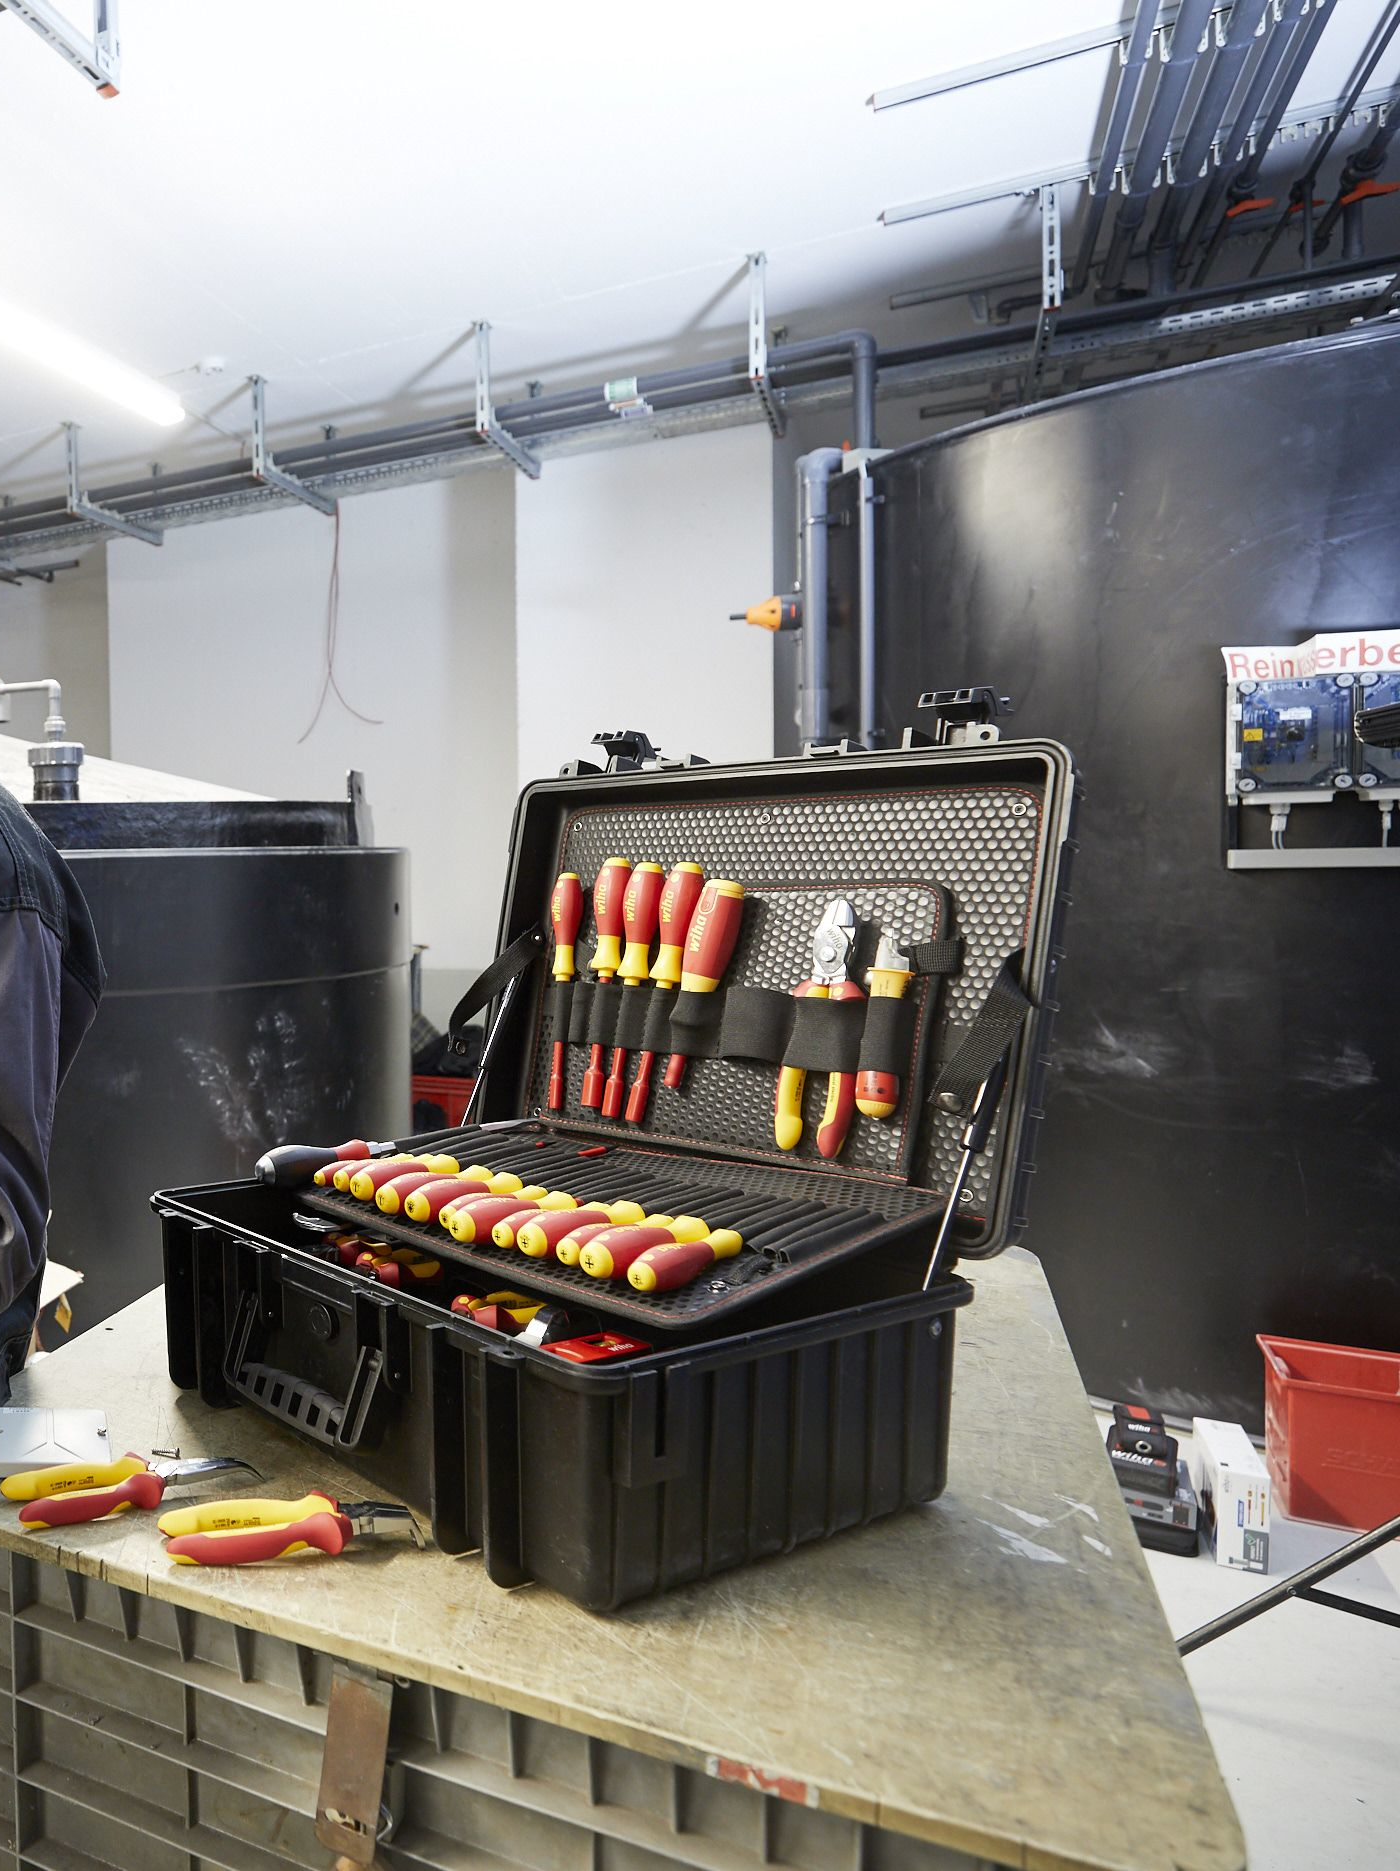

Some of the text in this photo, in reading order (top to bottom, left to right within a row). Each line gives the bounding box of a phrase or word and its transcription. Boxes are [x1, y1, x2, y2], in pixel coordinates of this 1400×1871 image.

[552, 895, 561, 922] wiha
[596, 884, 607, 915] wiha
[625, 890, 636, 922] wiha
[661, 890, 674, 923] wiha
[689, 914, 707, 952] wiha
[608, 1343, 634, 1352] wiha
[1128, 1423, 1151, 1434] wiha
[1111, 1449, 1154, 1467] wiha
